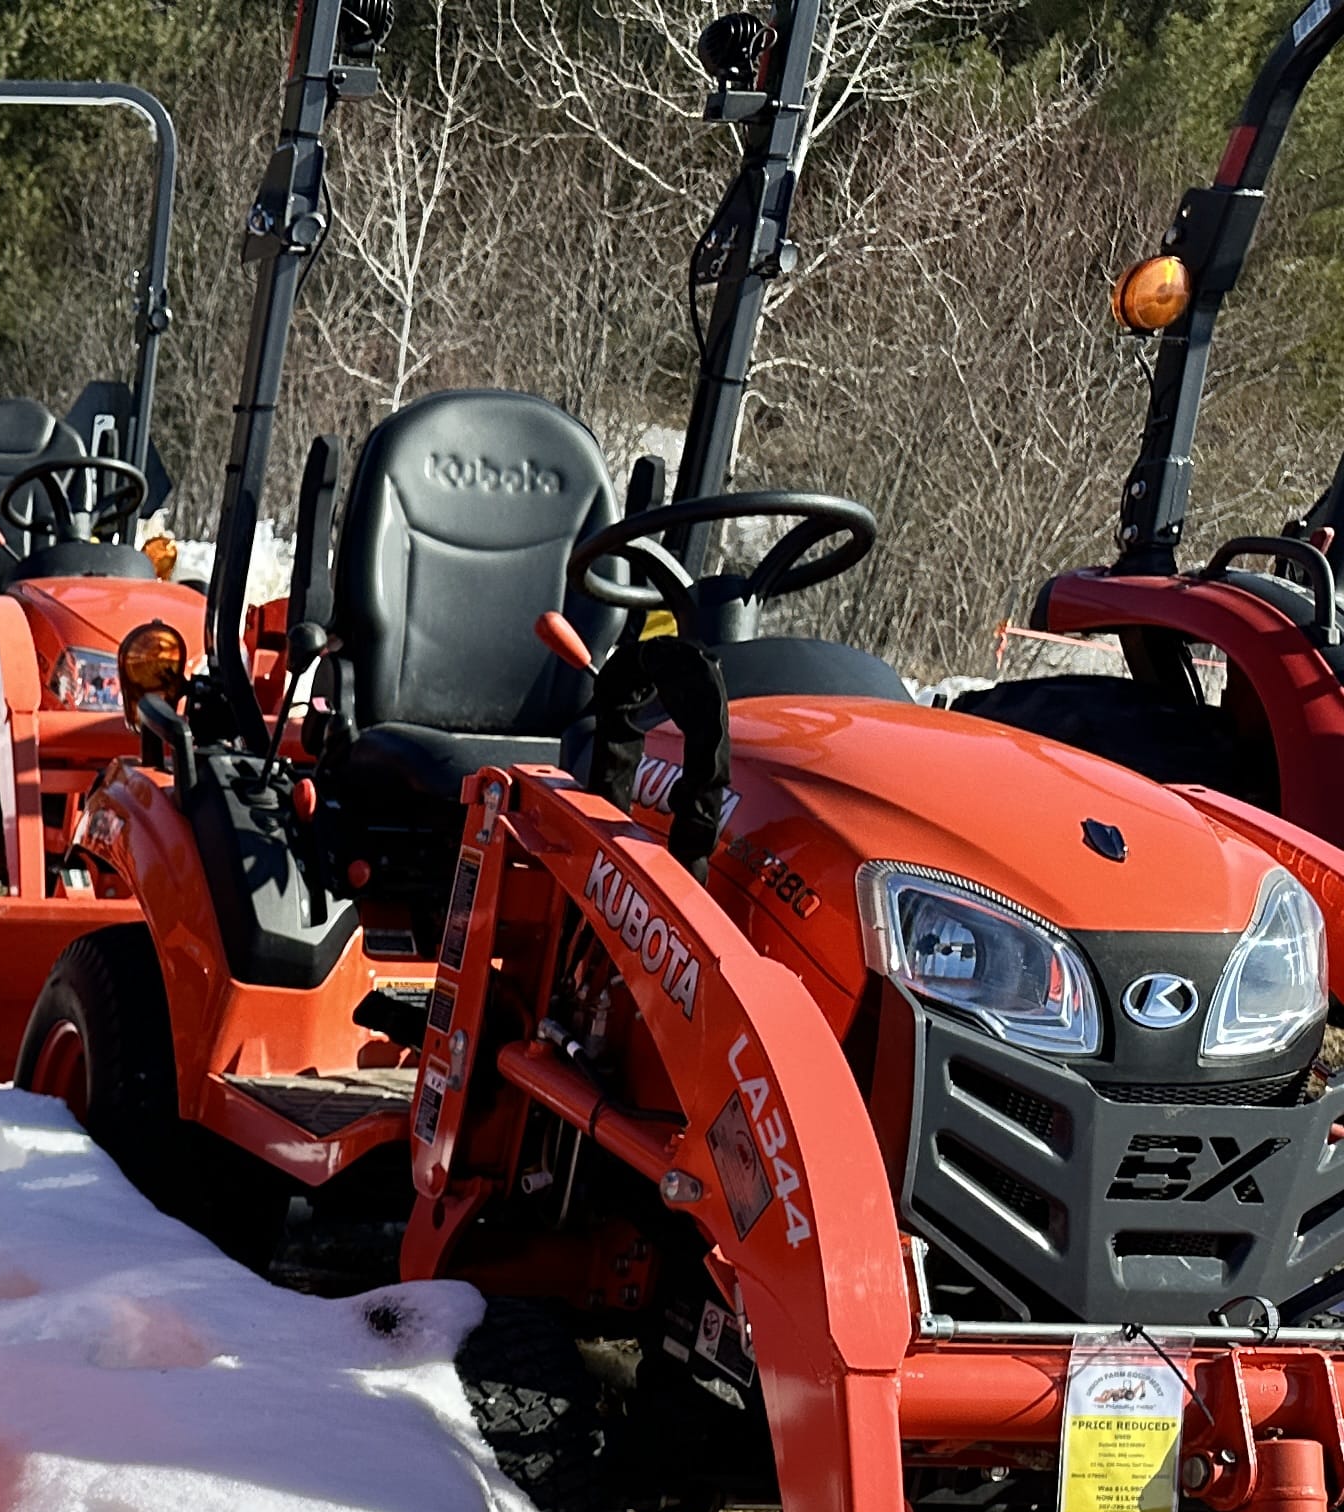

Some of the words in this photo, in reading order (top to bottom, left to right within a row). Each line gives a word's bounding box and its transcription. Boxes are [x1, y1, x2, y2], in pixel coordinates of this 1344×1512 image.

[423, 453, 562, 495] Kubota
[584, 849, 701, 1021] KUBOTA
[727, 1032, 812, 1250] LA344
[1104, 1133, 1292, 1205] BX
[1104, 1371, 1126, 1380] FARM
